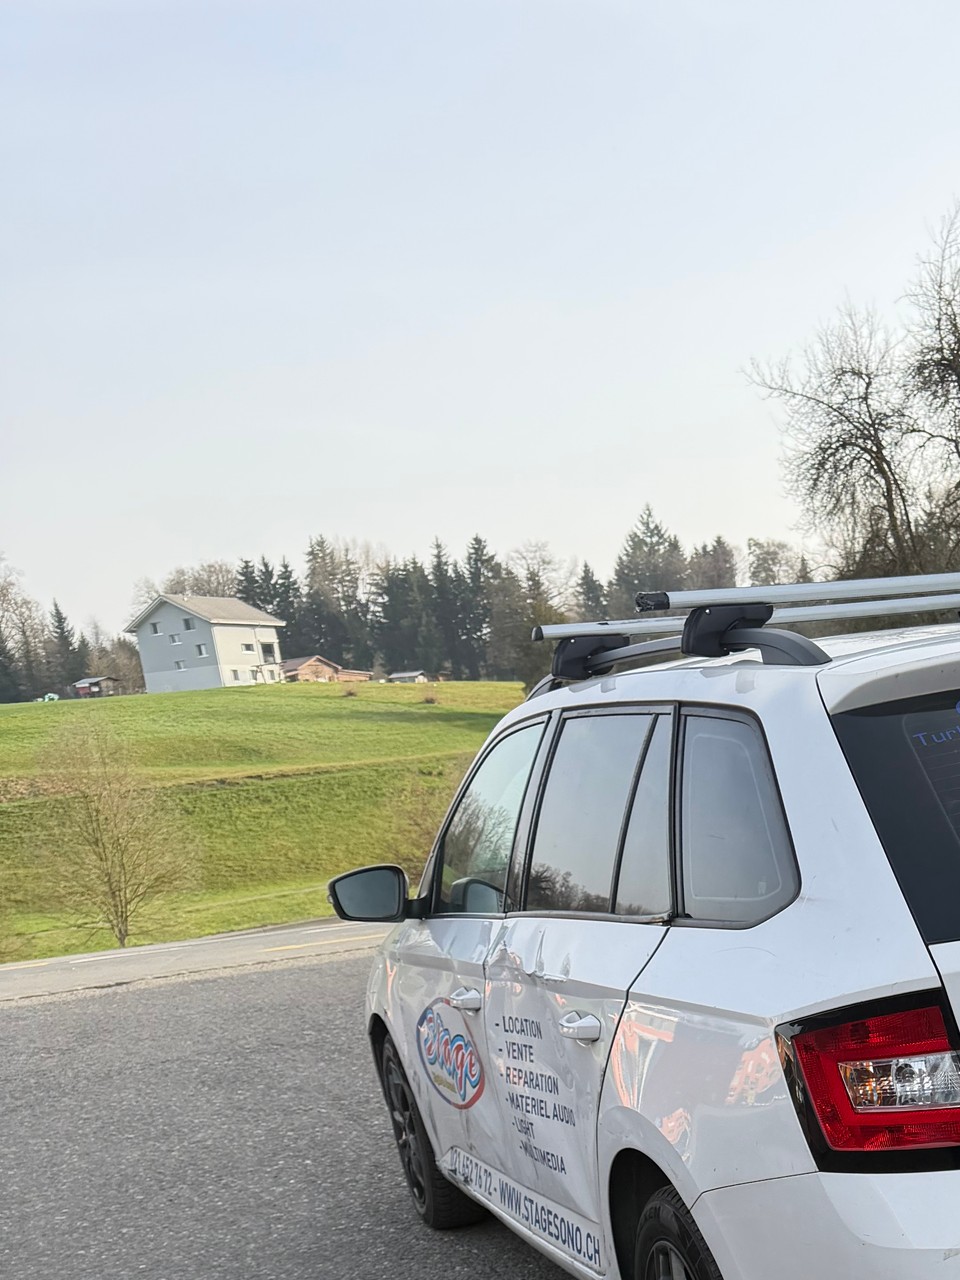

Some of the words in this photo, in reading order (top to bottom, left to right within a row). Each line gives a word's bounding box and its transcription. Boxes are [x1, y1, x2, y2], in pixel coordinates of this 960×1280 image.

[502, 1015, 543, 1040] LOCATION
[505, 1040, 534, 1063] VENTE
[505, 1066, 559, 1095] REPARATION
[498, 1178, 601, 1268] WWW.STAGESONO.CH
